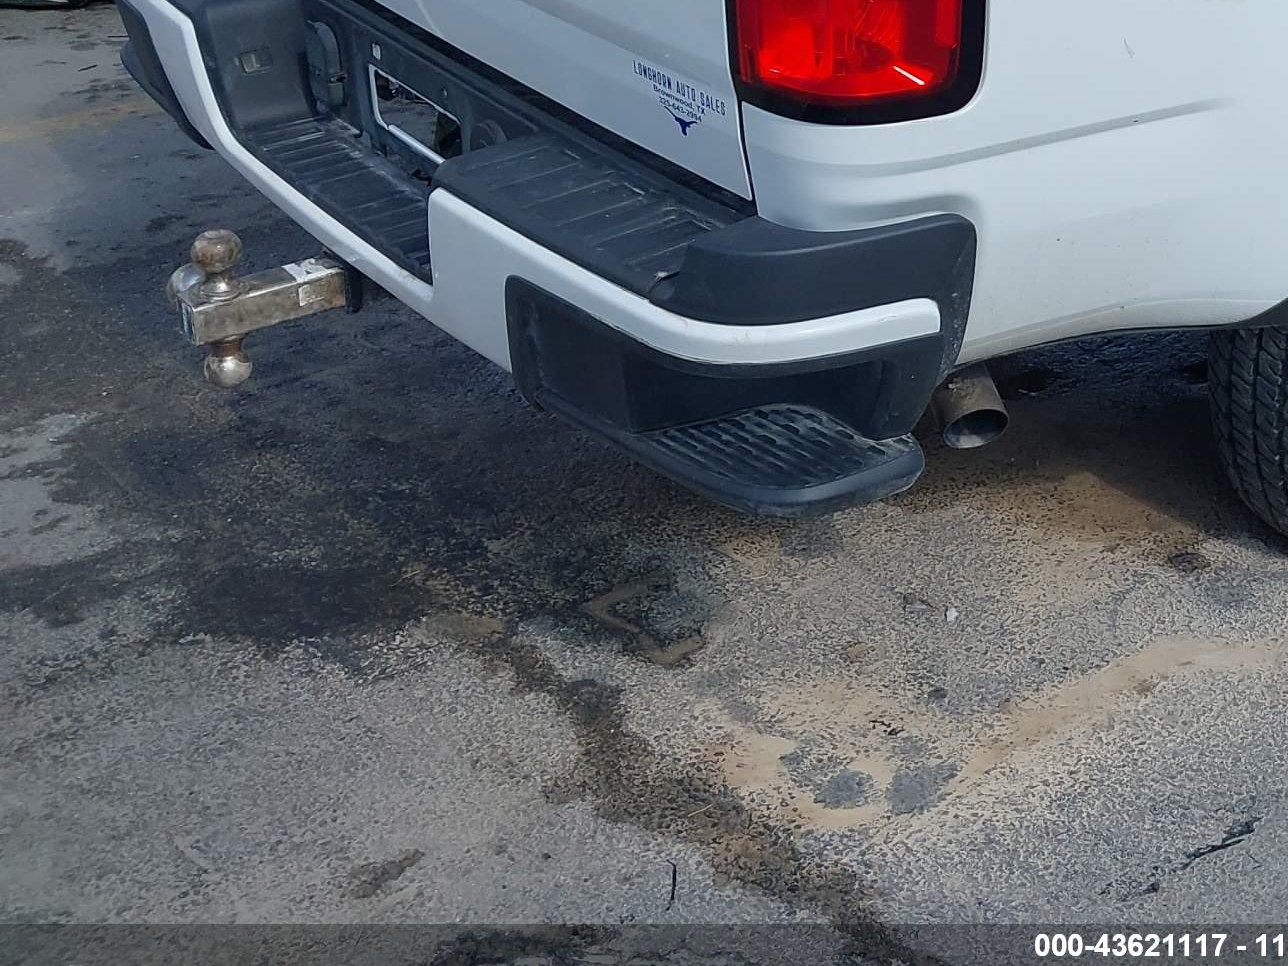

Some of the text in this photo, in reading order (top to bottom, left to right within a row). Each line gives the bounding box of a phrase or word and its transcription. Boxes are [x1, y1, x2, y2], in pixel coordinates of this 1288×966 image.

[633, 60, 726, 116] LONGHORN AUTO SALES
[696, 104, 706, 116] TX
